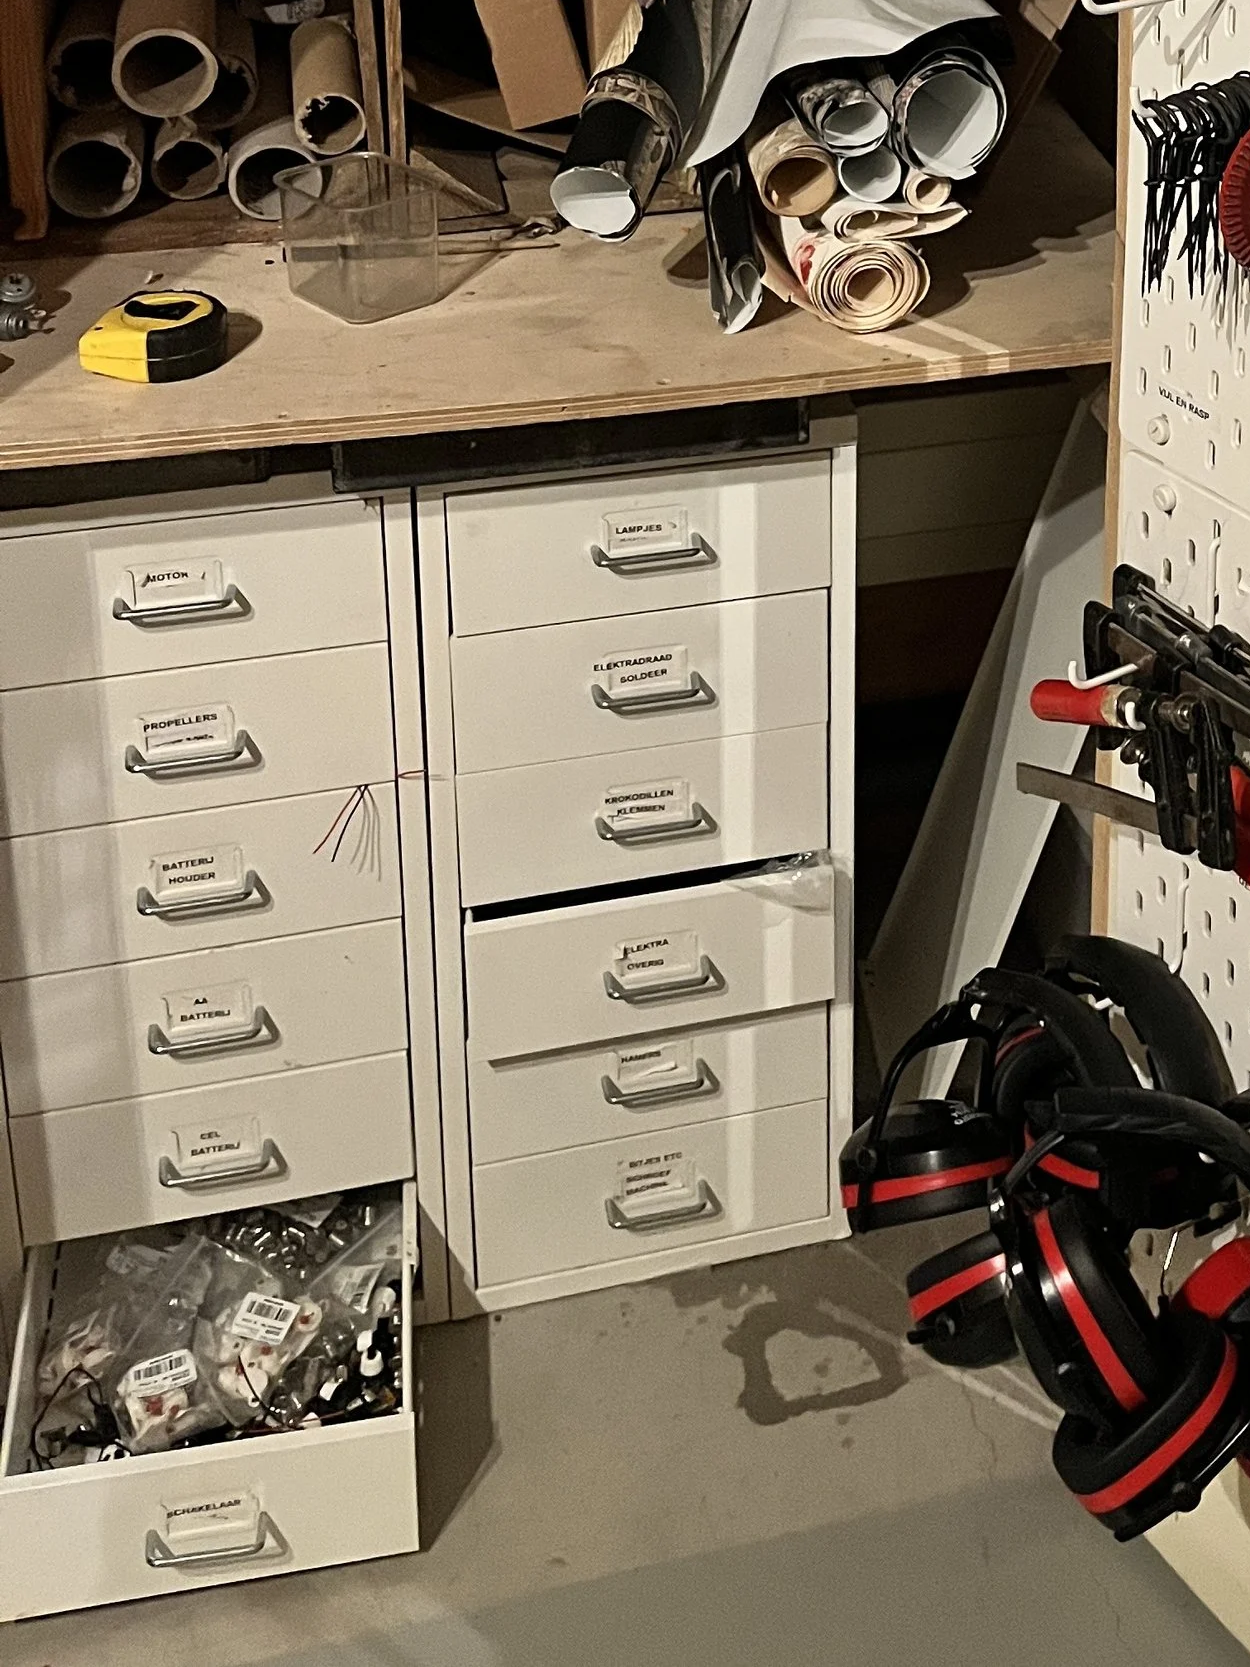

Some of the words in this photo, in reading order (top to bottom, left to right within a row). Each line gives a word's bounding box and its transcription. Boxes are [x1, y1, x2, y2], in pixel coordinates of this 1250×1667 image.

[1188, 402, 1211, 420] RASP
[615, 524, 662, 535] LAMPJES
[593, 653, 672, 672] ELEKTRADRAAD
[619, 668, 668, 684] SOLDEER
[143, 713, 218, 733] PROPELLERS
[604, 789, 674, 805] KROKODILLEN
[168, 872, 216, 885] HOUDER
[623, 938, 669, 956] ELEKTRA
[165, 1499, 241, 1520] SCHAKELAAR
